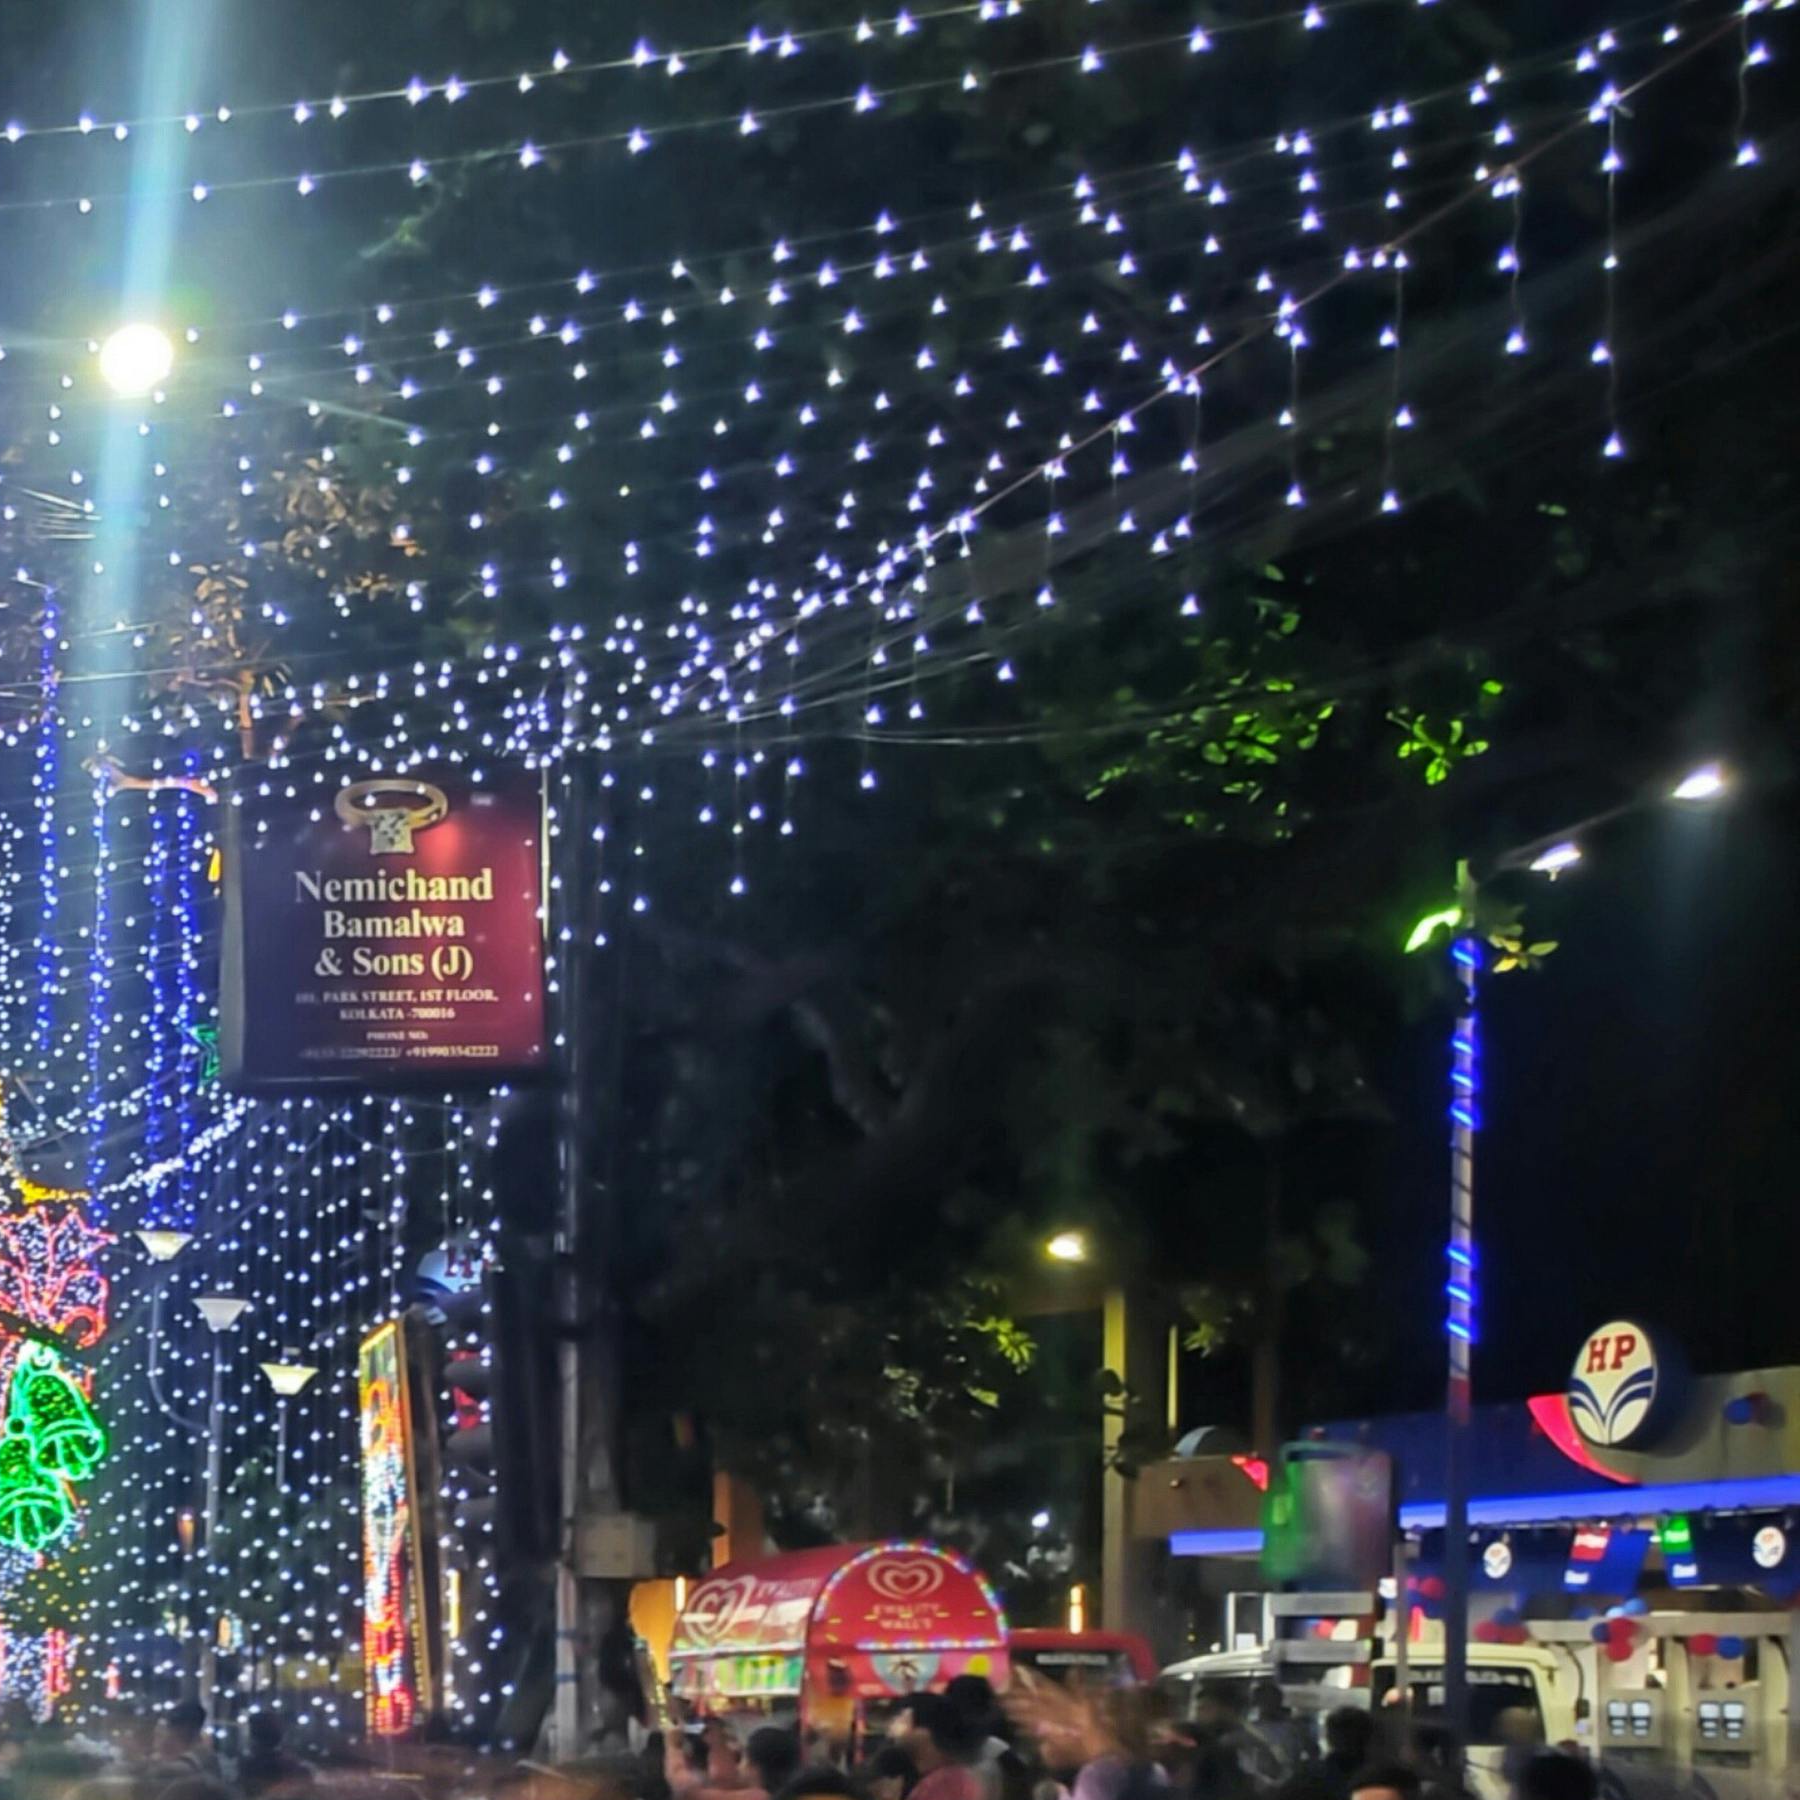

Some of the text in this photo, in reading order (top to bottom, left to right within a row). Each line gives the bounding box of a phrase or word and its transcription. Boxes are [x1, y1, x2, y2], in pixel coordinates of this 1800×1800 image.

[295, 868, 494, 904] Nemichand
[323, 910, 465, 939] Bamalwa
[314, 945, 474, 981] & Sons (J)
[1585, 1333, 1636, 1375] HP
